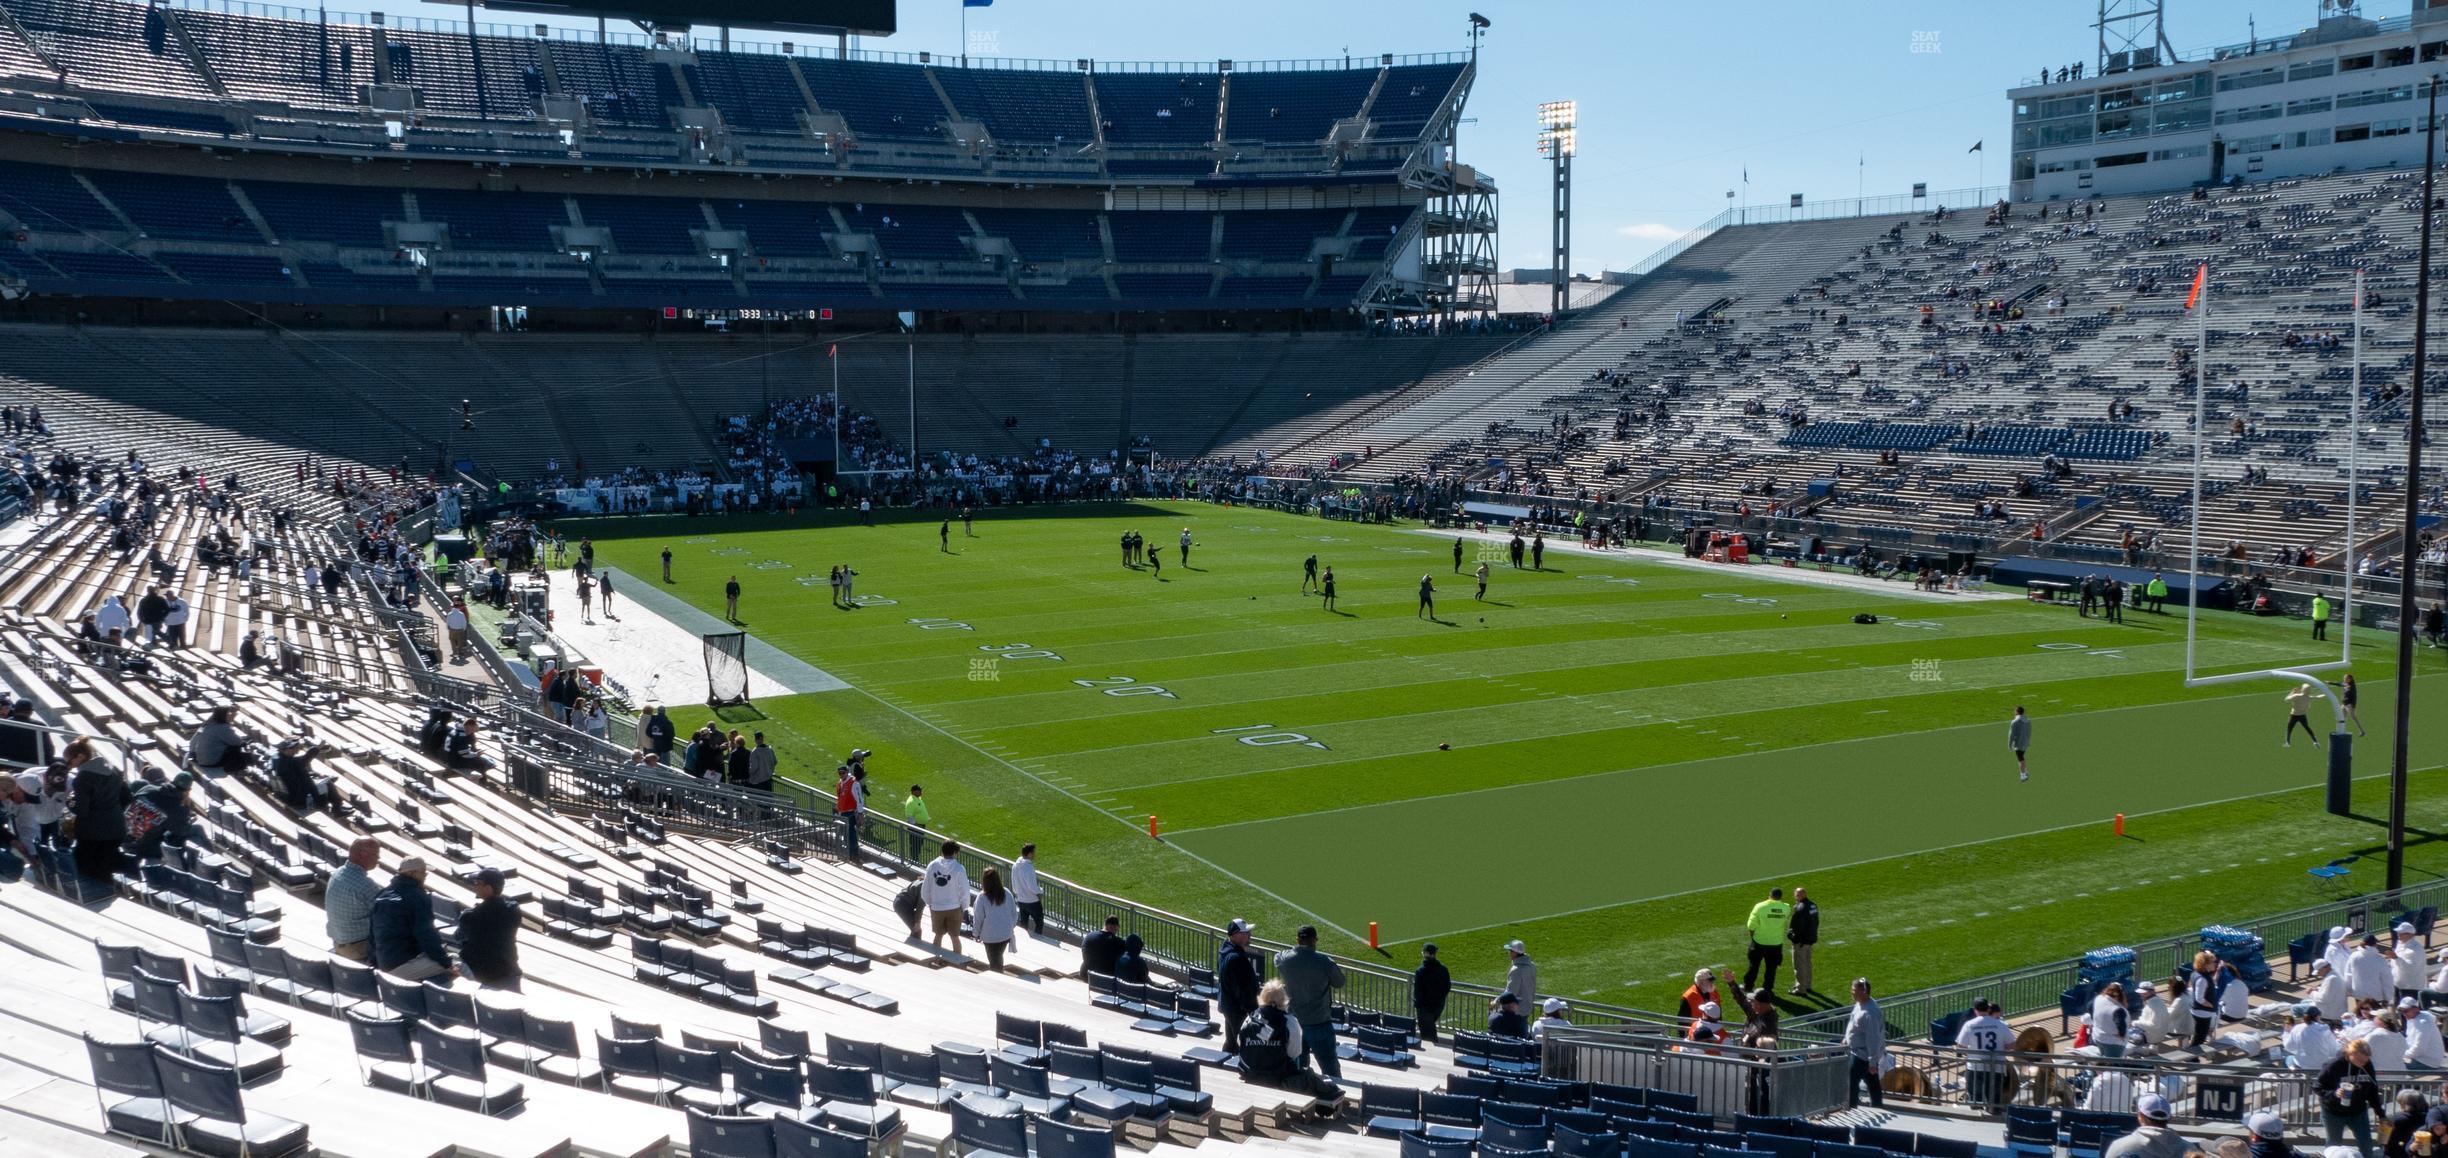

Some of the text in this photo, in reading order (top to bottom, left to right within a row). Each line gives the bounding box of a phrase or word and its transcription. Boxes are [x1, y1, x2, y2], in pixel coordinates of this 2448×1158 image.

[977, 642, 1057, 660] 30
[1071, 675, 1166, 698] 20
[1210, 724, 1313, 748] 10
[1974, 1031, 1998, 1050] 13
[2203, 1089, 2238, 1112] NJ
